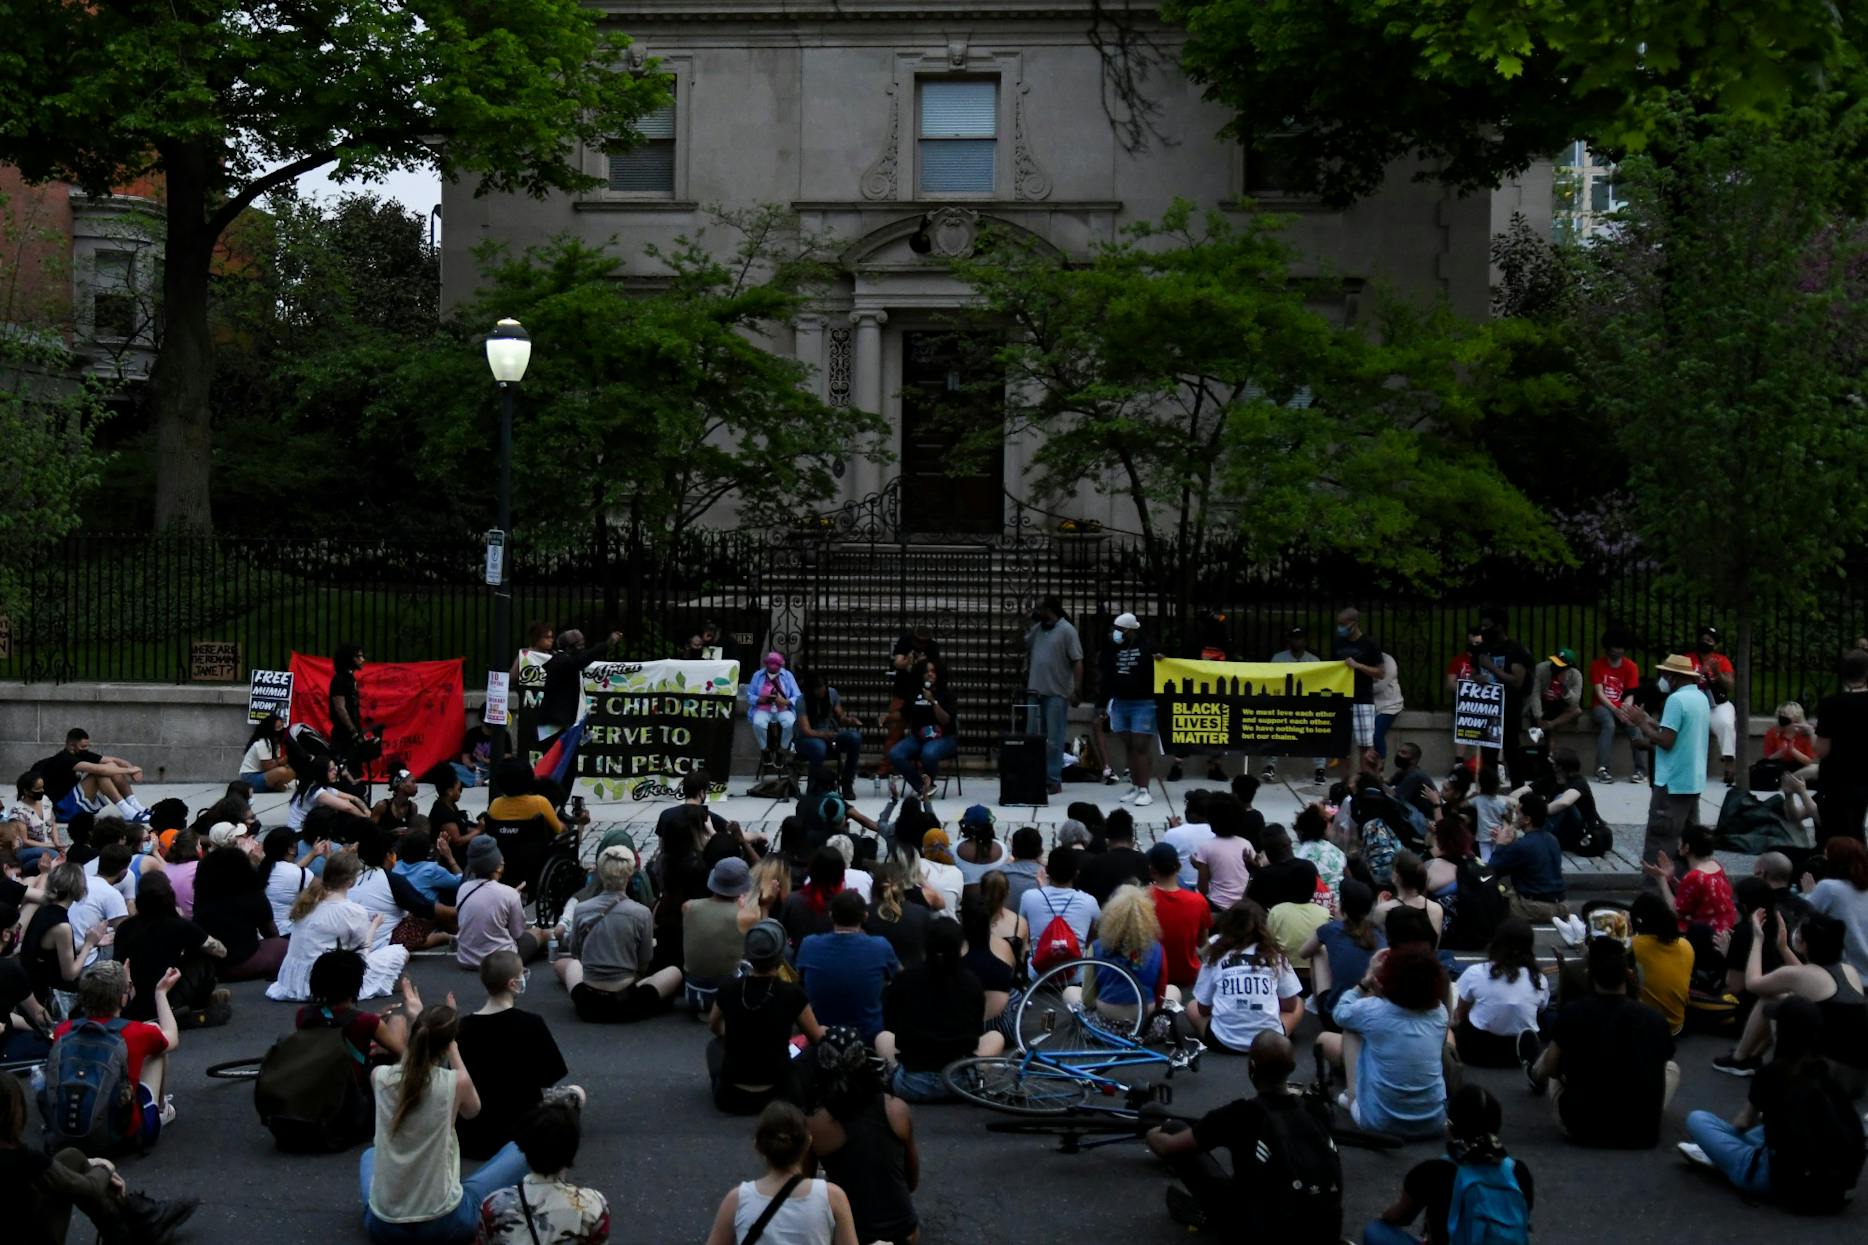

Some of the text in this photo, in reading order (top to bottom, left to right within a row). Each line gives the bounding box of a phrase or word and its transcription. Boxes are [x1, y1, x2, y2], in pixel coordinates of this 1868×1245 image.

[254, 671, 292, 686] FREE
[252, 686, 288, 698] MUMIA
[1460, 682, 1501, 701] FREE
[606, 697, 734, 720] CHILDREN
[1172, 702, 1222, 715] BLACK
[1242, 708, 1255, 716] We
[1277, 709, 1294, 717] love
[1295, 710, 1314, 718] each
[1458, 700, 1500, 716] MUMIA
[1175, 718, 1219, 729] LIVES
[1222, 703, 1231, 733] PHILLY
[1257, 718, 1287, 726] support
[1457, 716, 1488, 729] NOW!
[660, 725, 692, 746] TO
[1276, 726, 1305, 734] nothing
[1172, 731, 1230, 745] MATTER
[1271, 733, 1299, 741] chains.
[596, 757, 624, 775] IN
